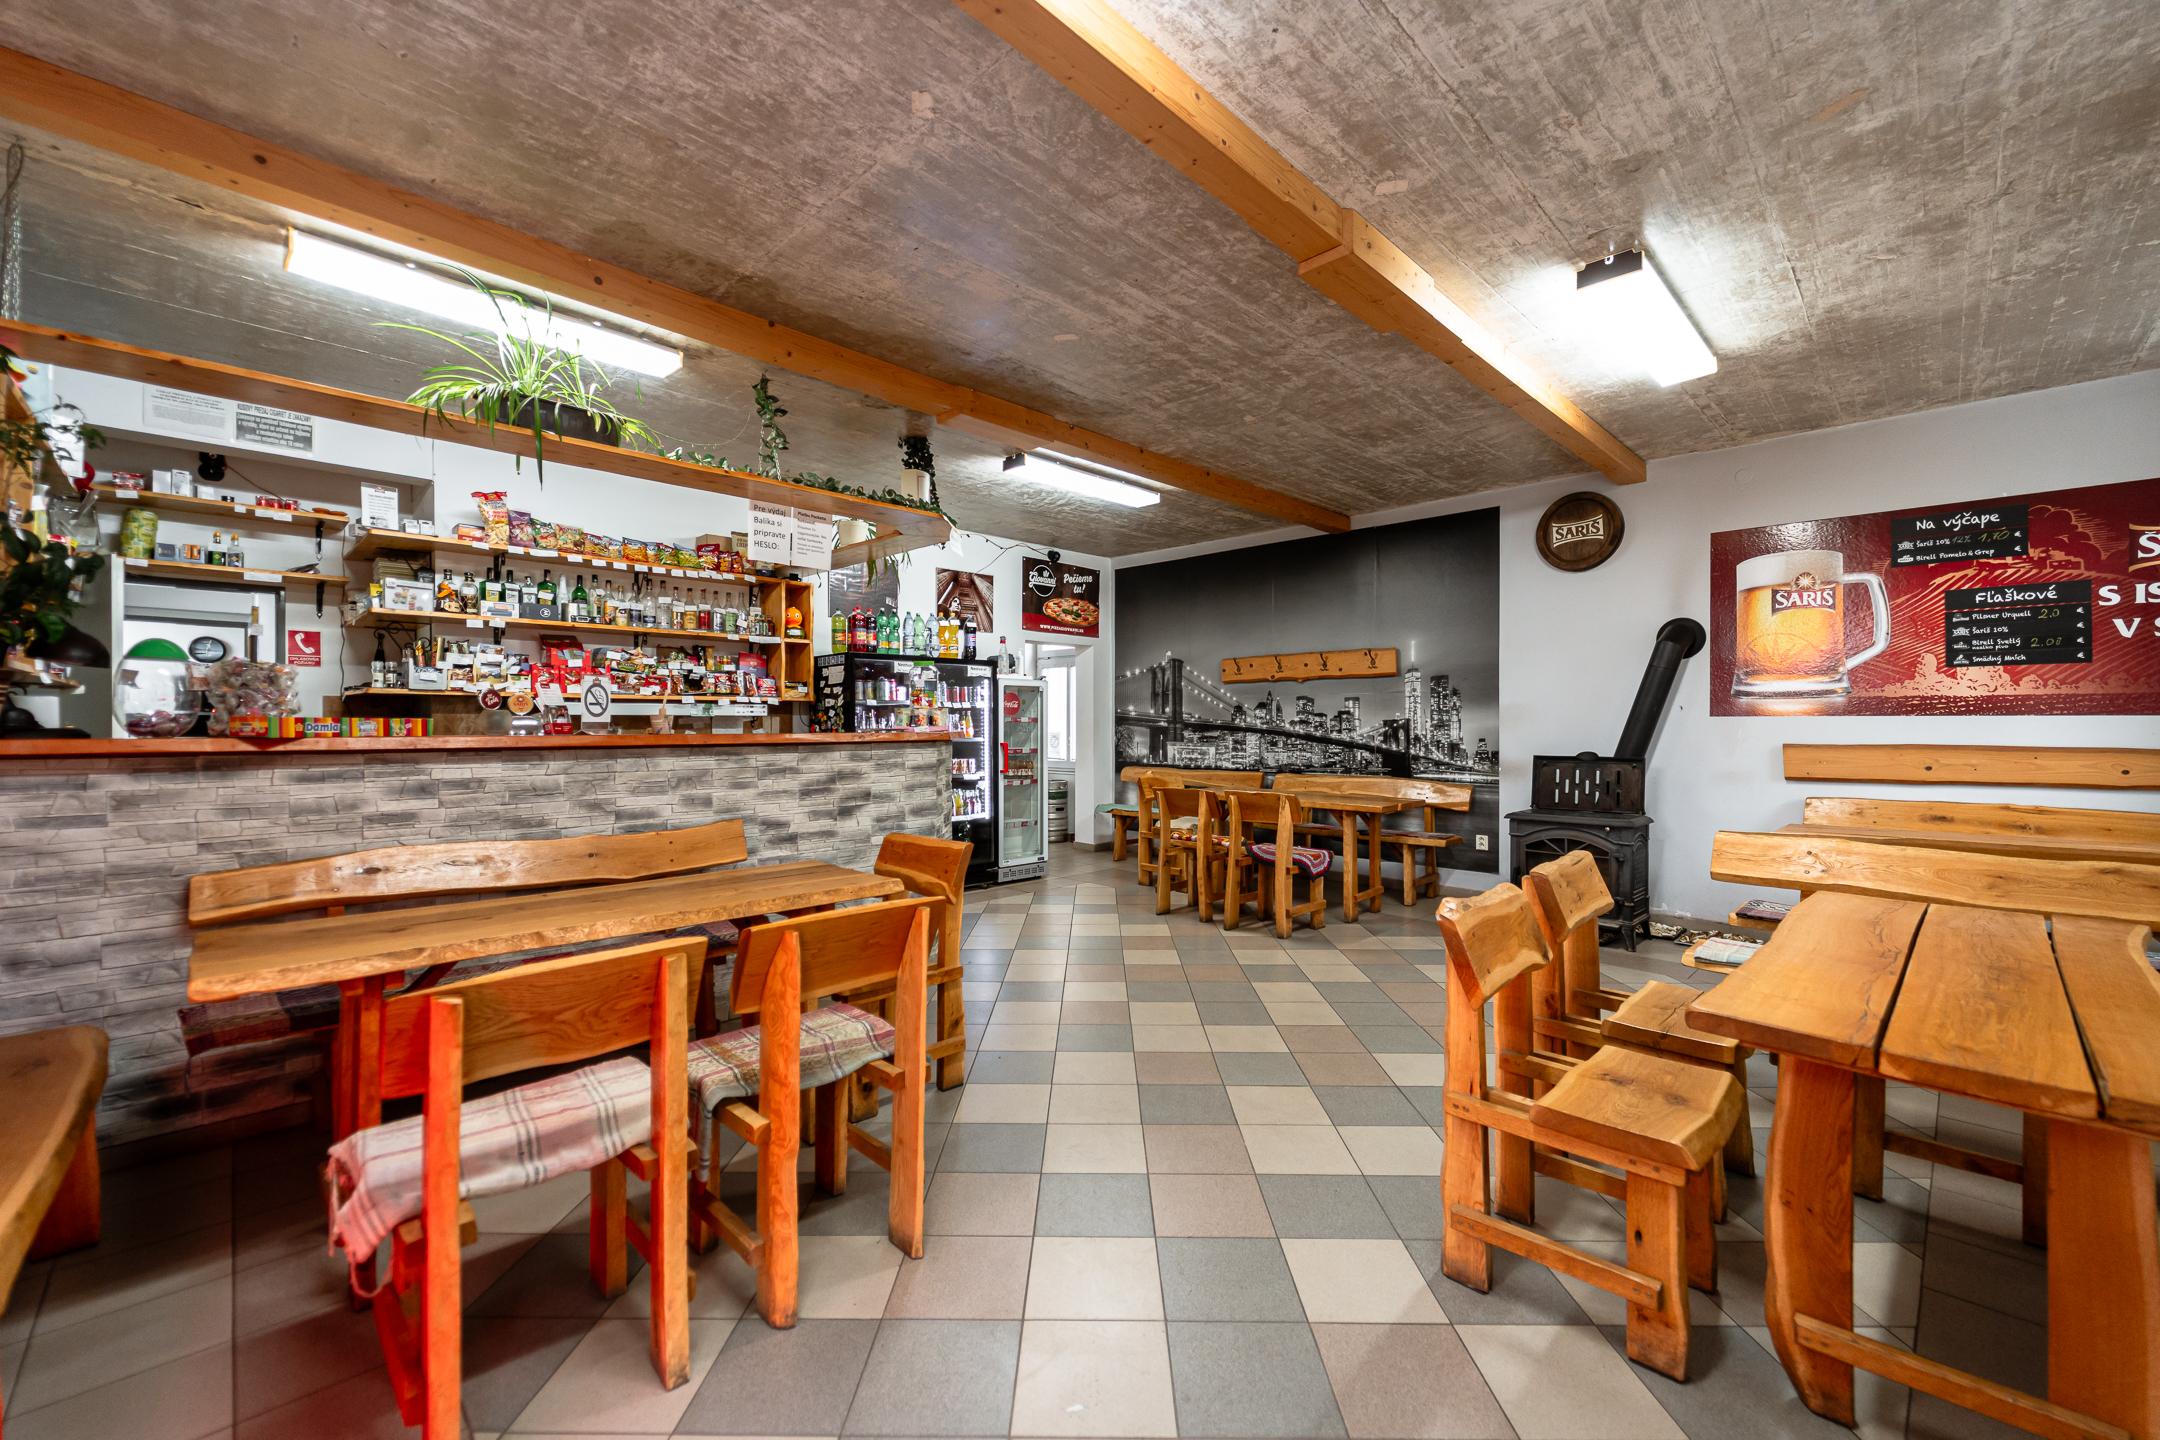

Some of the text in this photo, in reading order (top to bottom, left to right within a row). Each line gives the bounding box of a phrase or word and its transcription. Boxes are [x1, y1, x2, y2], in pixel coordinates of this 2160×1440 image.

[753, 504, 786, 517] Pre výdaj
[1916, 511, 2000, 531] Na výčape
[753, 529, 786, 540] pripravte
[754, 540, 780, 551] HESLO:
[1916, 540, 1934, 548] Šariš
[1939, 551, 1967, 559] Pomelo
[1974, 548, 1995, 558] Grep
[1063, 573, 1093, 584] Pečieme
[1073, 583, 1086, 594] tu!
[1975, 584, 2058, 604] Fľaškové
[1775, 588, 1834, 609] ŠARIŠ
[2098, 585, 2121, 606] S
[2002, 610, 2032, 620] Urquell
[1972, 626, 1990, 634] Šariš
[1993, 625, 2009, 633] 10%
[2112, 617, 2142, 639] V
[1997, 637, 2021, 646] Svetlý
[1972, 653, 2002, 664] Smädný
[2004, 652, 2026, 661] Mních
[305, 722, 340, 733] Damla
